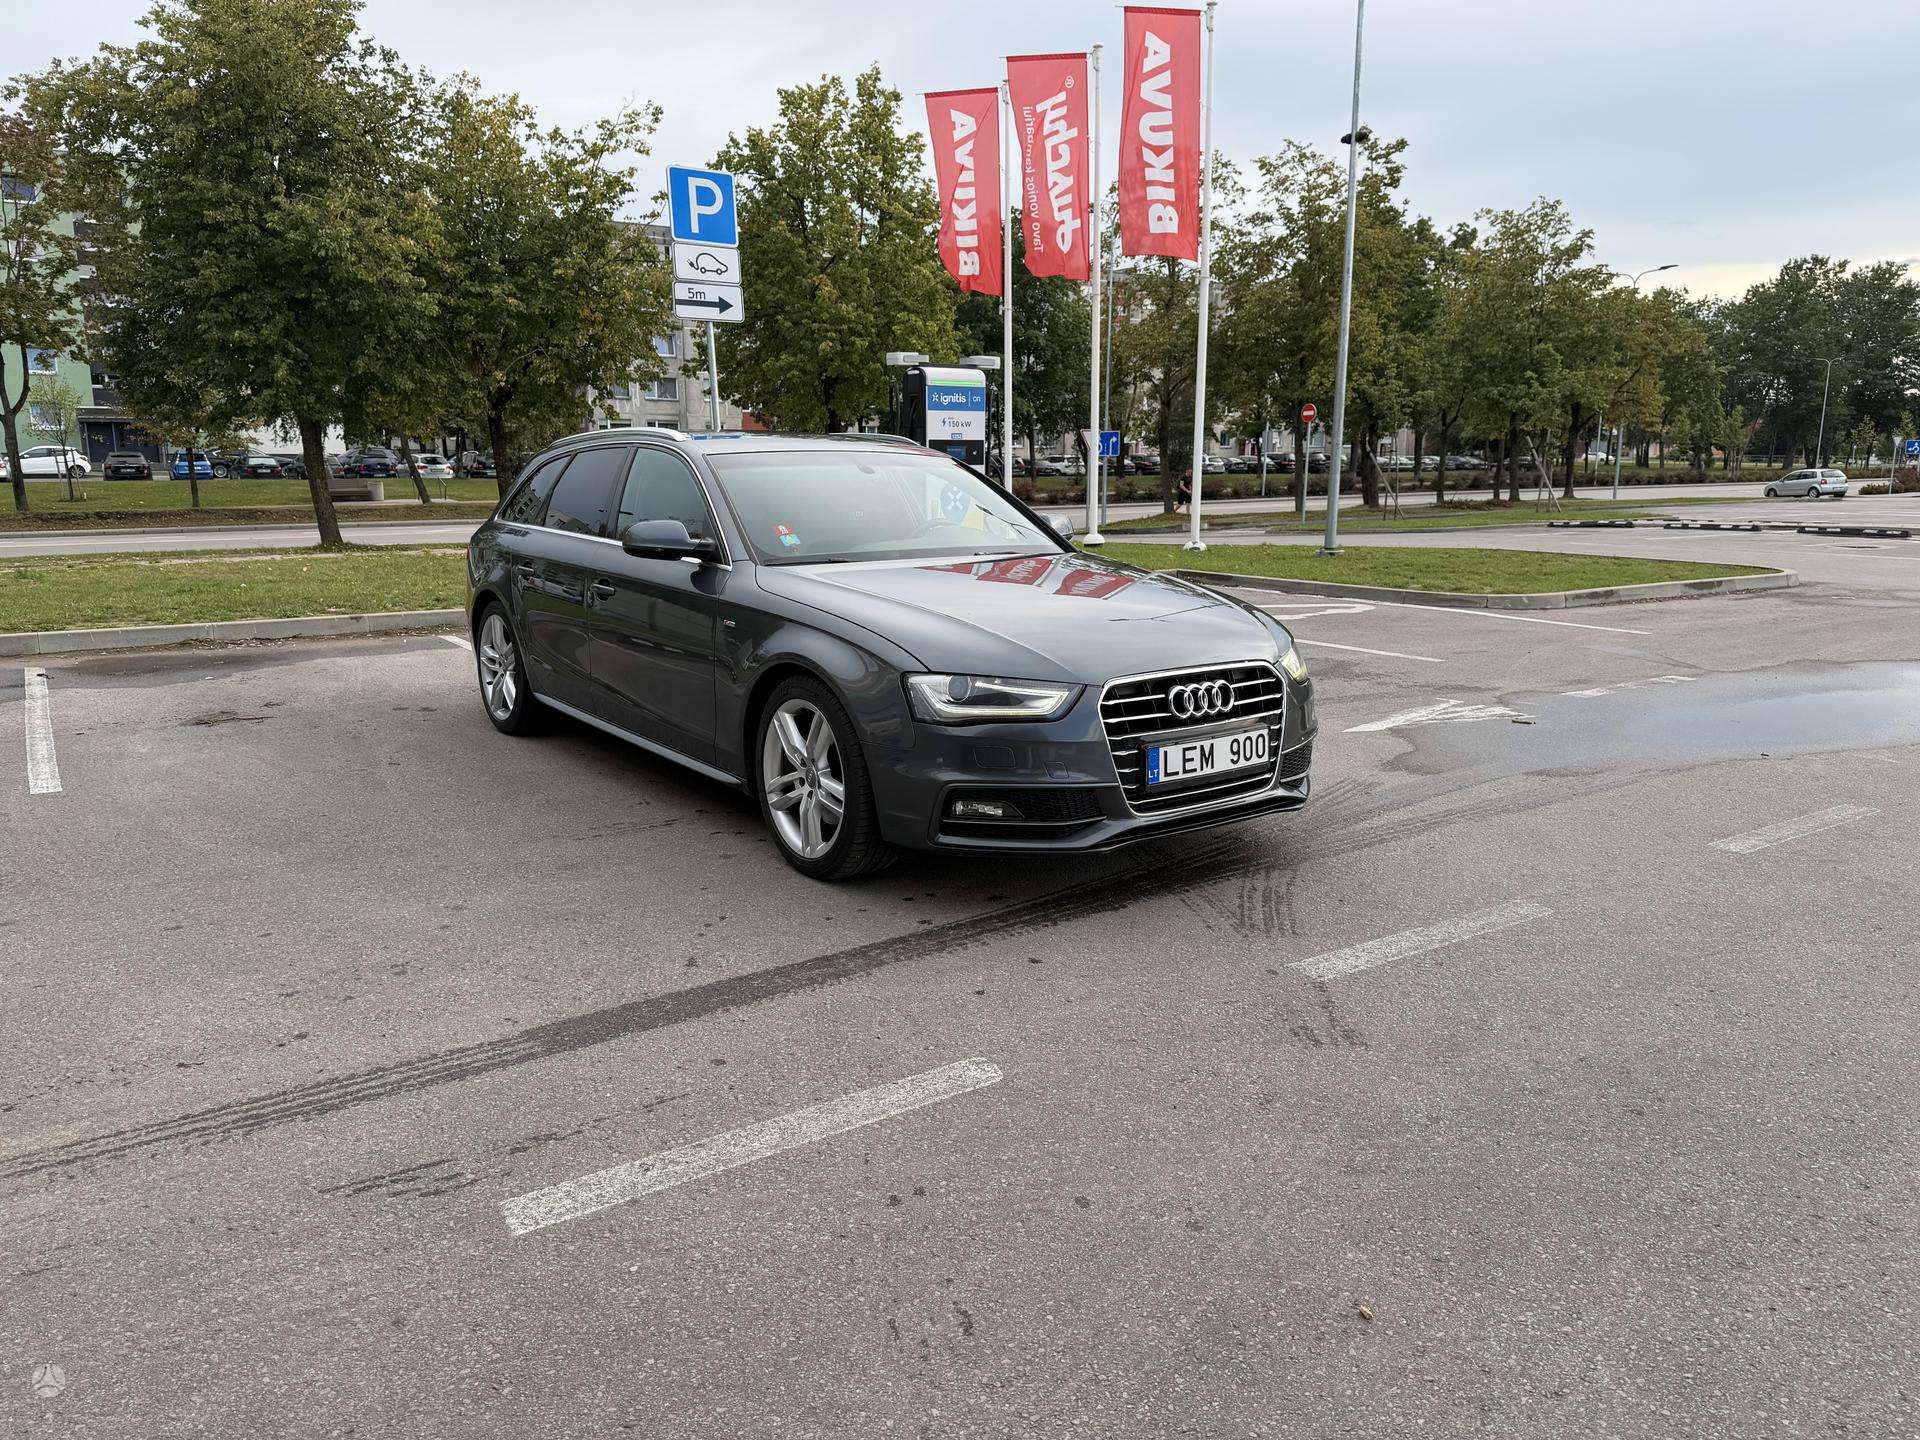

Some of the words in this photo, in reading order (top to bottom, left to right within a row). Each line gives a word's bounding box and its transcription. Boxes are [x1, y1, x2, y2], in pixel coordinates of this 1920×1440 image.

[687, 176, 724, 233] P
[688, 288, 706, 300] 5m
[940, 393, 967, 405] ignitis
[1163, 742, 1215, 778] LEM
[1229, 733, 1266, 765] 900
[1148, 768, 1159, 779] LT
